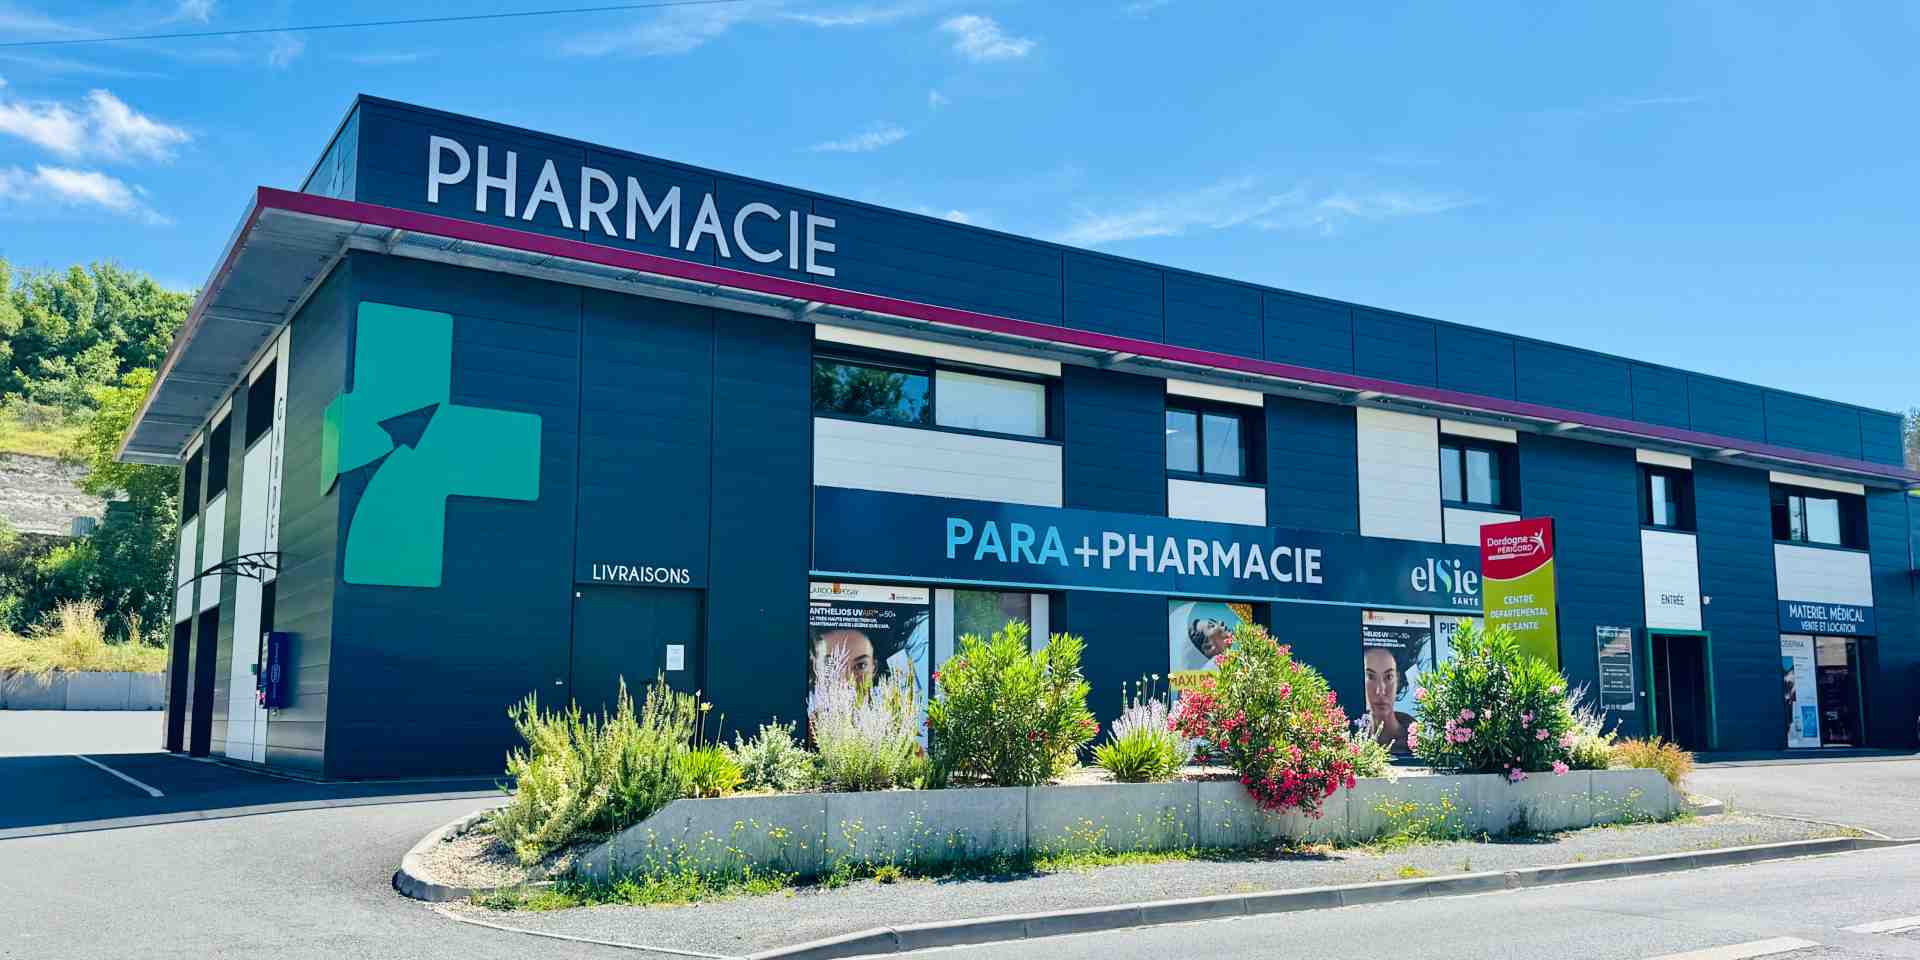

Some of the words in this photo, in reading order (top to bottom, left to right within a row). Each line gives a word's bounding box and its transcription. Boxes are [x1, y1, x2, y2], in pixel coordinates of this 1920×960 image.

[428, 135, 836, 277] PHARMACIE
[1487, 535, 1529, 547] Dordogne
[593, 564, 690, 584] LIVRAISONS
[1503, 594, 1536, 605] CENTRE
[810, 608, 852, 616] ANTHELIOS
[1829, 605, 1865, 622] MÉDICAL
[1800, 621, 1818, 631] VENTE
[1819, 621, 1826, 632] ET
[1827, 622, 1857, 633] LOCATION
